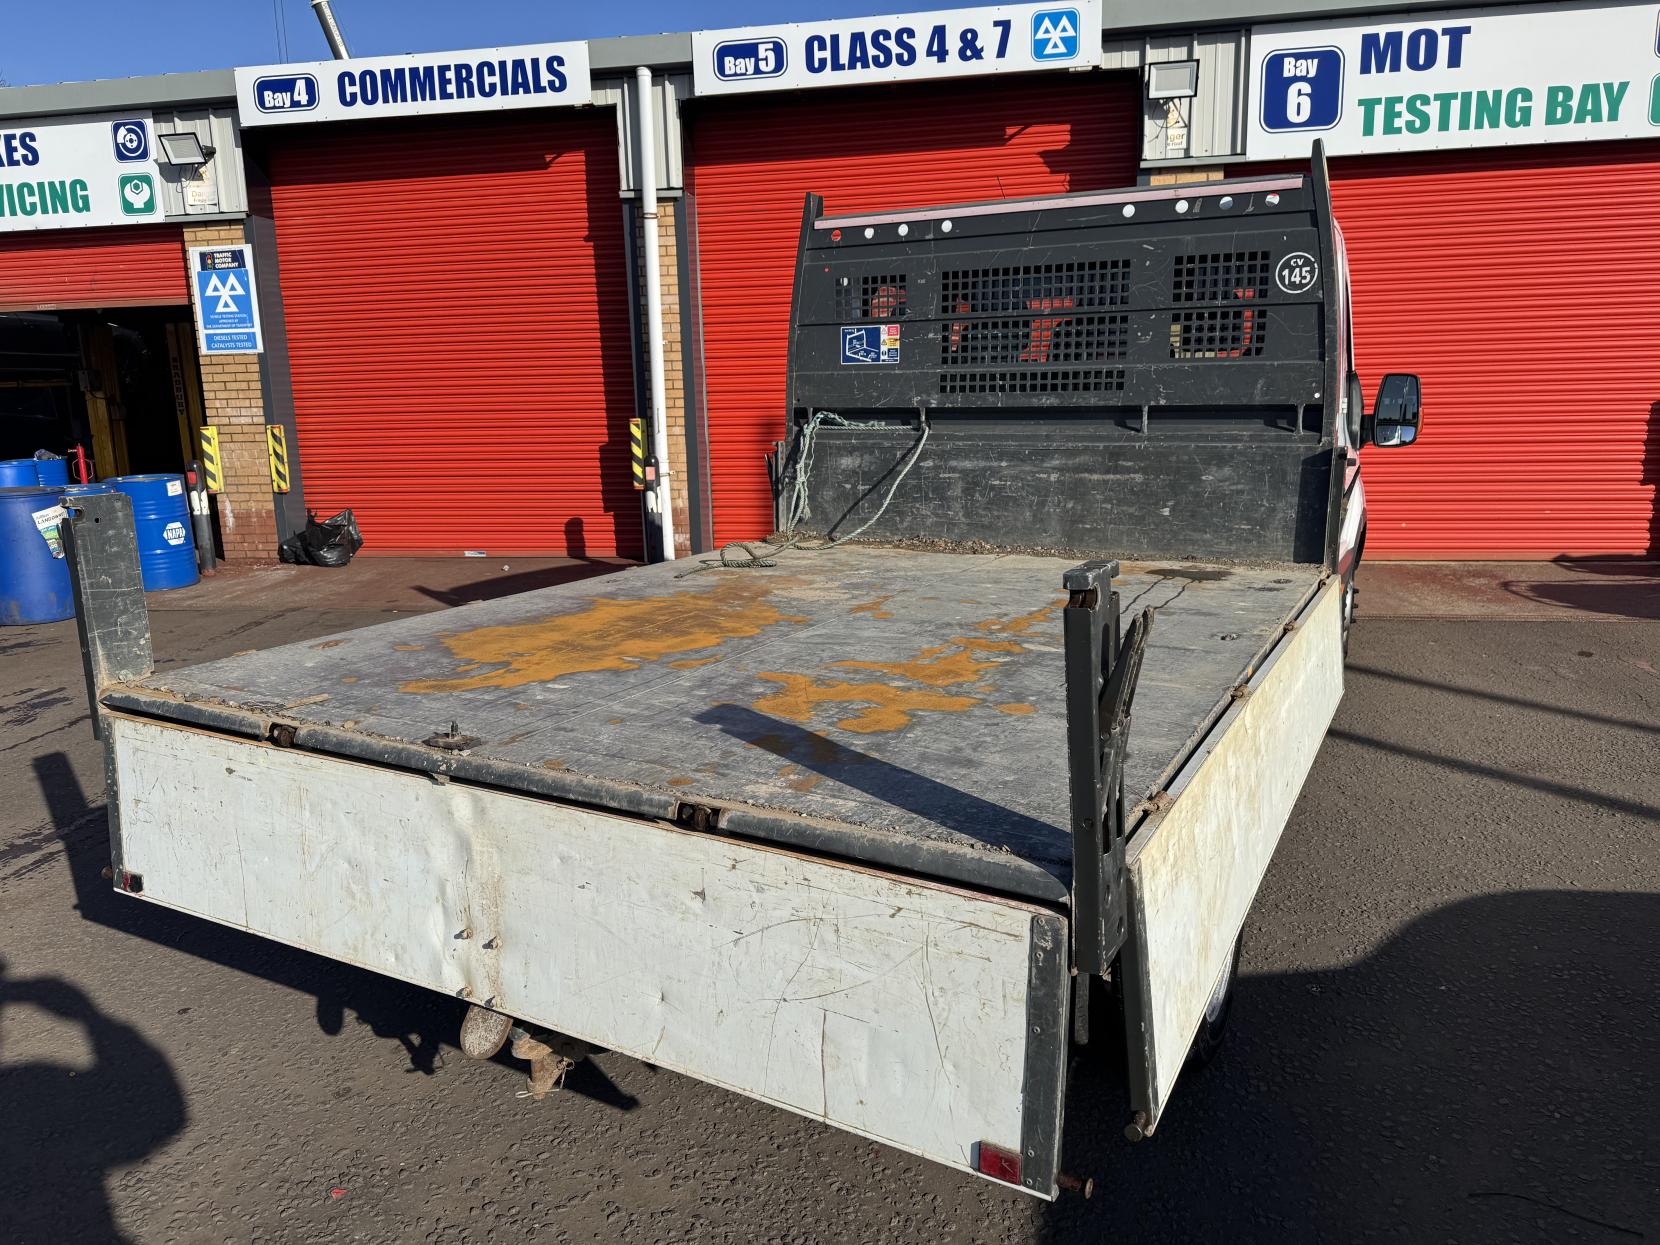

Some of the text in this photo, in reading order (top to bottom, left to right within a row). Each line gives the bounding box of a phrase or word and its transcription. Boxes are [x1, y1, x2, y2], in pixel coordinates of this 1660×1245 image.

[724, 43, 775, 75] Bay 5
[805, 20, 1012, 74] CLASS 4 & 7
[1359, 26, 1472, 75] MOT
[337, 55, 568, 107] COMMERCIALS
[1283, 57, 1319, 78] Bay
[264, 79, 309, 108] Bay 4
[1286, 81, 1312, 124] 6
[1357, 80, 1631, 137] TESTING BAY
[0, 132, 40, 168] ES
[1282, 266, 1310, 285] 145
[1290, 258, 1304, 266] CV
[167, 527, 184, 540] NAPA
